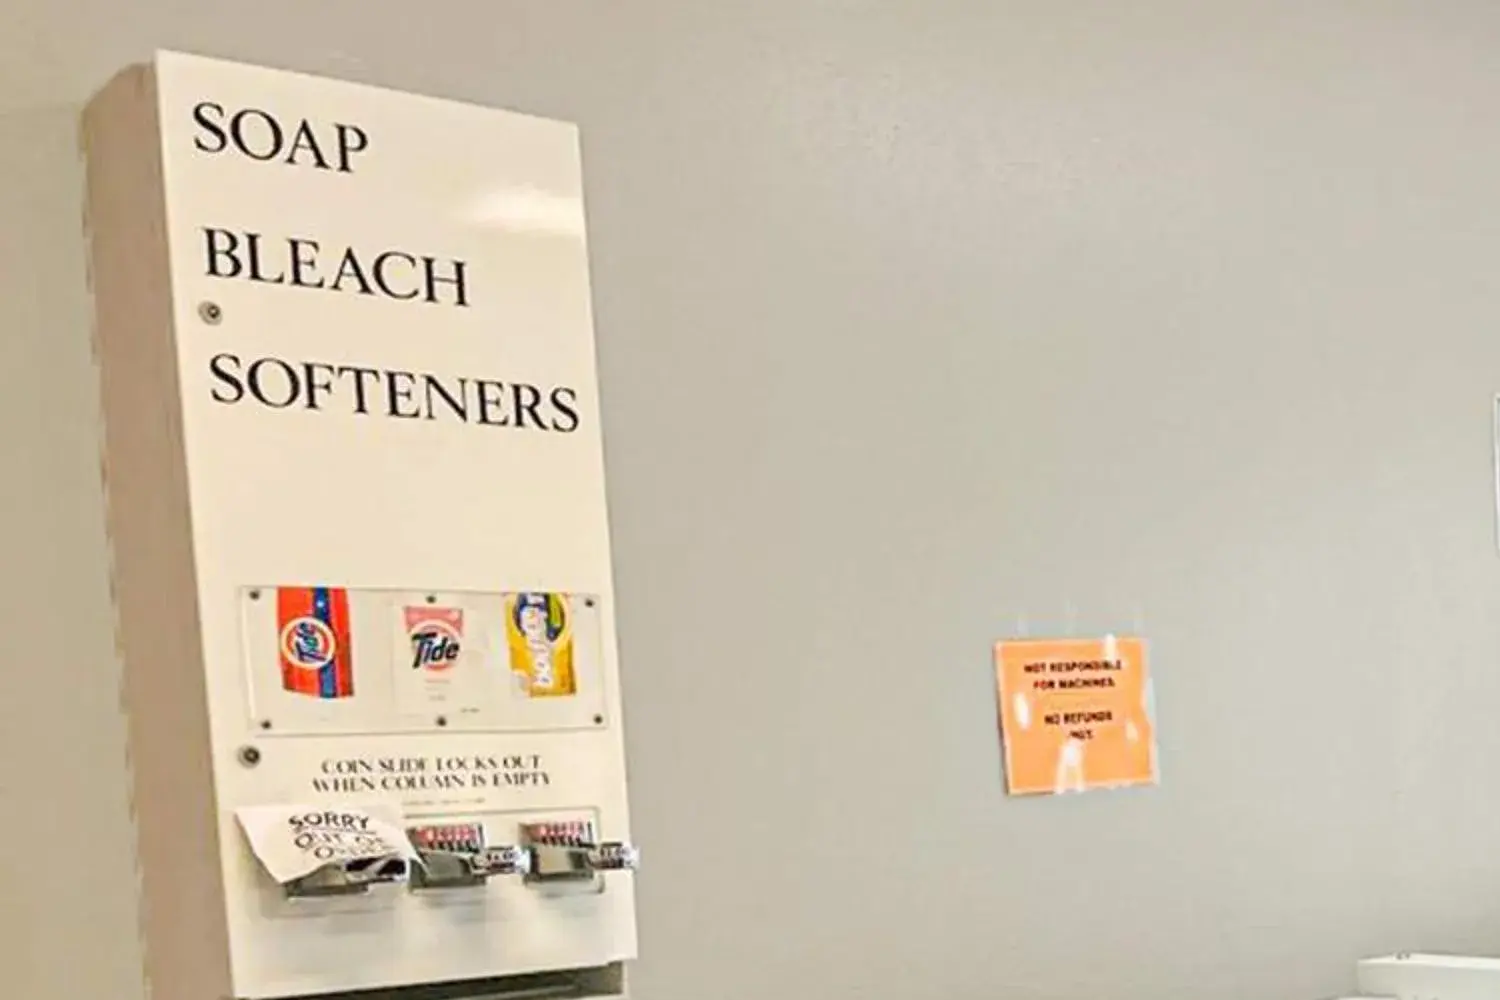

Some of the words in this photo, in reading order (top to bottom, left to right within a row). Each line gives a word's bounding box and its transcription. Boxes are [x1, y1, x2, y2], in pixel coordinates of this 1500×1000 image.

[193, 101, 369, 173] SOAP
[202, 226, 471, 307] BLEACH
[208, 353, 581, 434] SOFTENERS
[411, 631, 460, 669] Tide
[1024, 661, 1046, 674] NOT
[1050, 659, 1121, 672] RESPONSIBLE
[1033, 679, 1054, 690] FOR
[1044, 713, 1060, 725] NO
[1063, 710, 1112, 724] REFUNDS
[321, 757, 373, 774] COIN
[378, 757, 428, 773] SLIDE
[436, 756, 500, 771] LOCKS
[503, 754, 542, 769] OUT
[311, 776, 376, 792] WHEN
[381, 774, 465, 791] COLUMN
[471, 773, 487, 788] IS
[493, 771, 551, 788] EMPTY
[288, 811, 369, 832] SORRY
